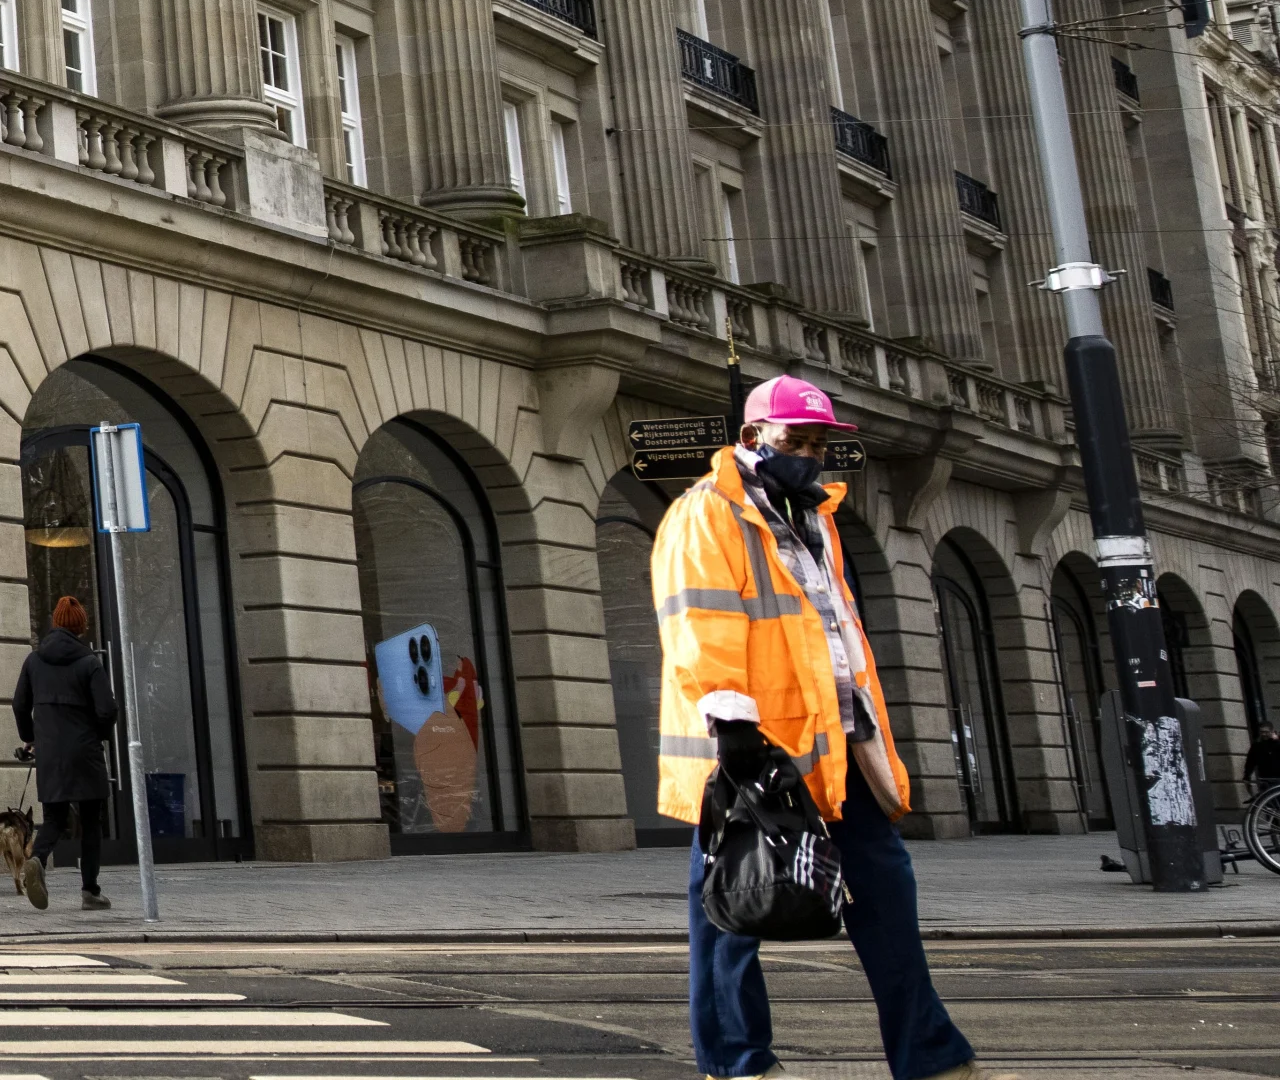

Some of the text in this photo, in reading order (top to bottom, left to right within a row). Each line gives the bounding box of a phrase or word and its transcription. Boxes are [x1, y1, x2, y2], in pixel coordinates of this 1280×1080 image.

[643, 421, 705, 431] Weteringcircuit
[644, 430, 696, 439] Rijksmuseum
[645, 438, 689, 446] Oosterpark
[647, 451, 695, 461] Vijzelgracht
